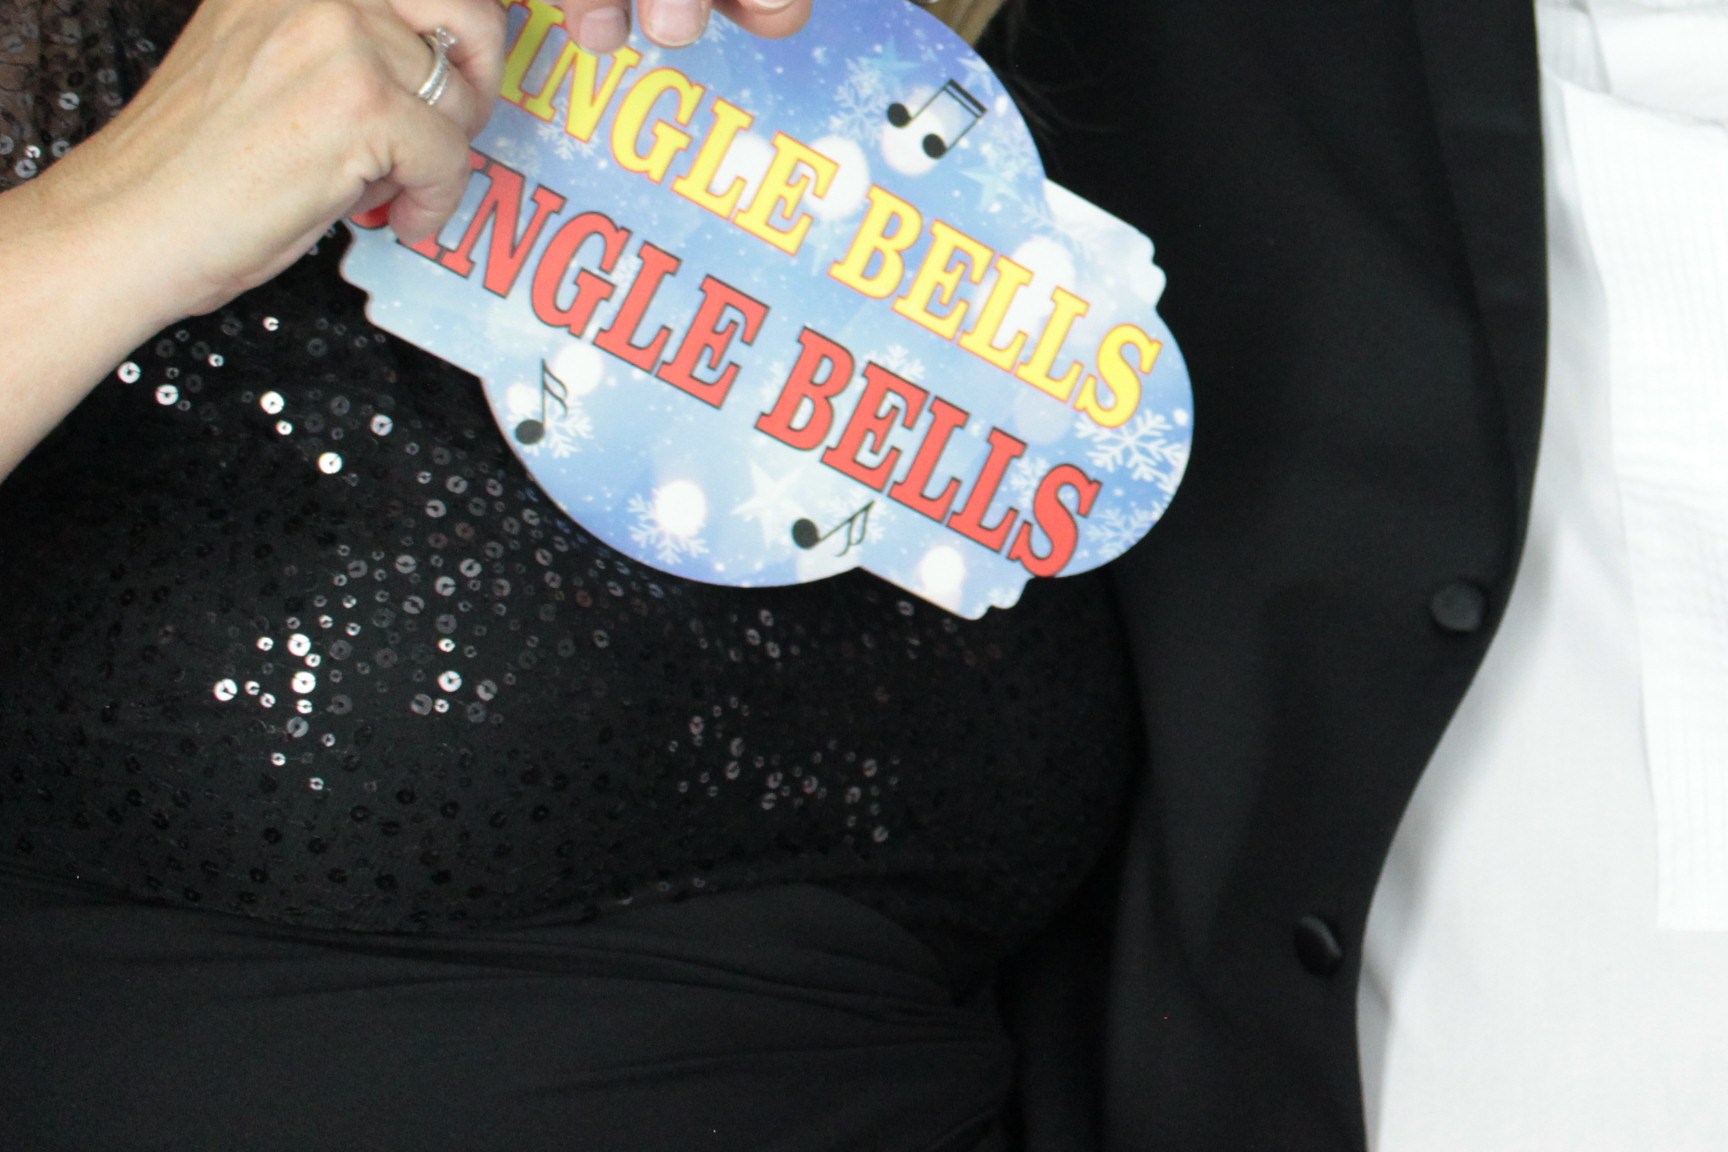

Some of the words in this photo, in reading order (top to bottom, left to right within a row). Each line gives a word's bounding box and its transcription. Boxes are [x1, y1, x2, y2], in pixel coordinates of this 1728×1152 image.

[350, 146, 769, 410] NGLE
[756, 328, 1102, 578] BELLS
[828, 184, 1162, 428] BELLS
